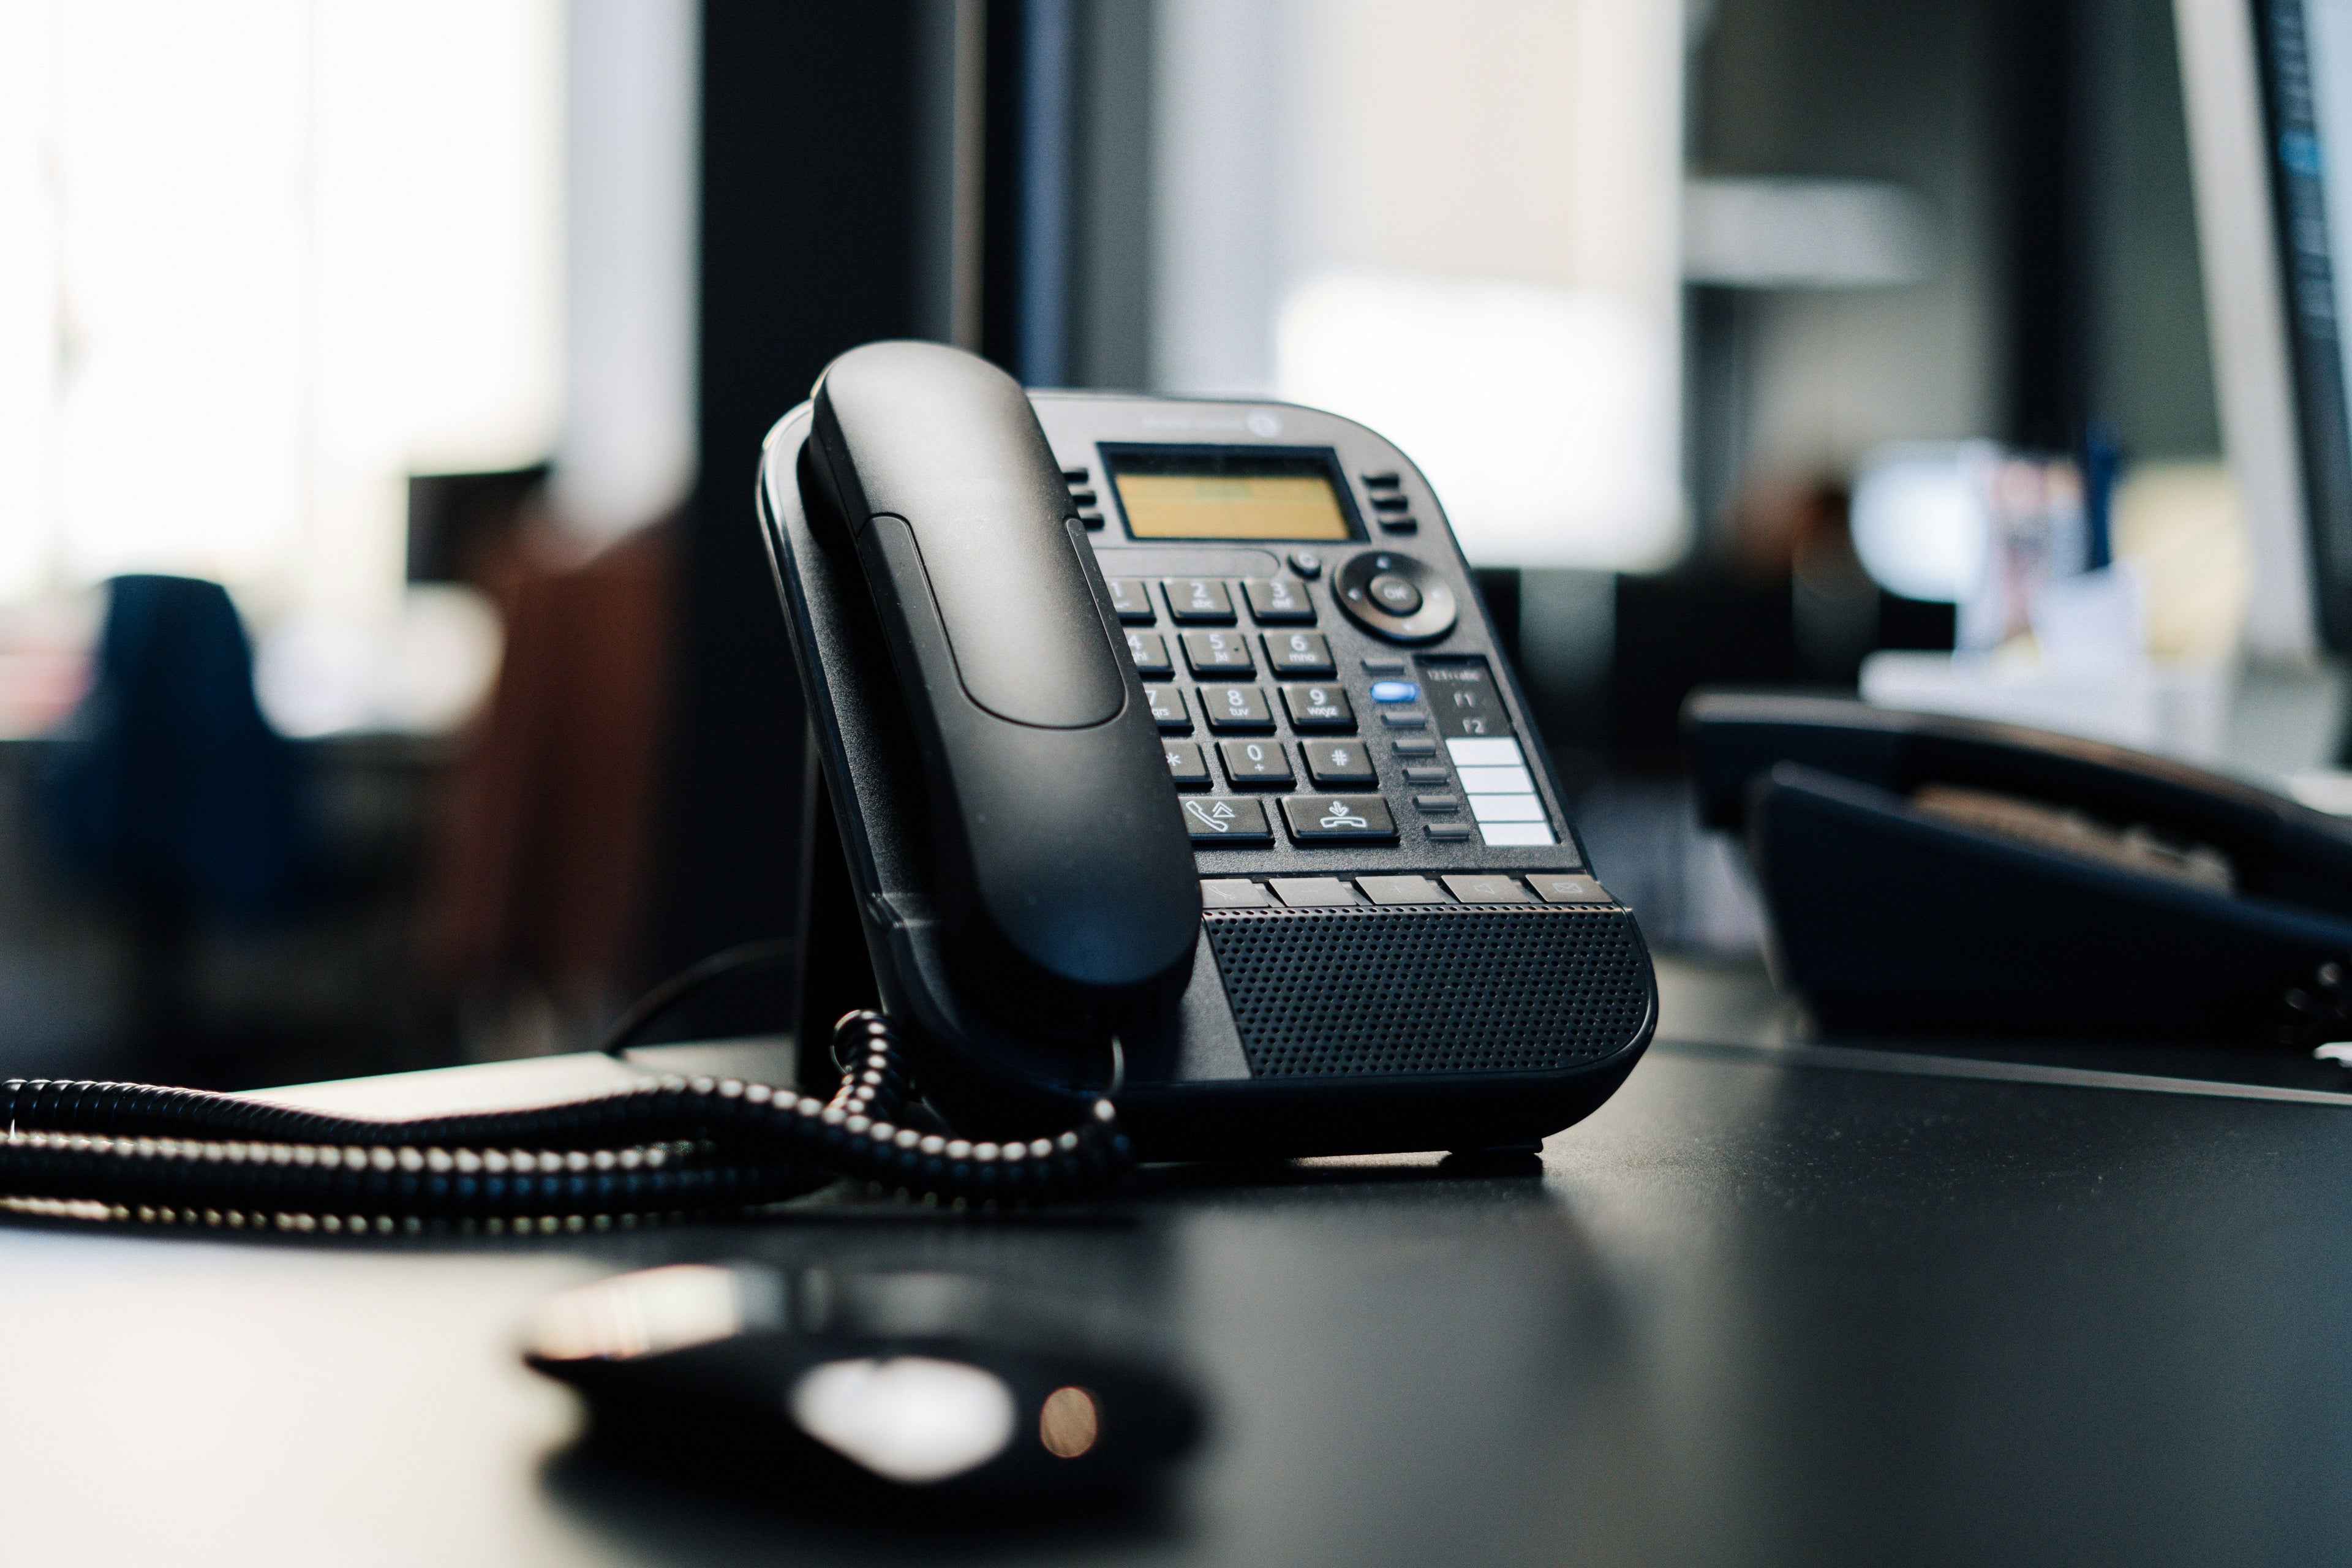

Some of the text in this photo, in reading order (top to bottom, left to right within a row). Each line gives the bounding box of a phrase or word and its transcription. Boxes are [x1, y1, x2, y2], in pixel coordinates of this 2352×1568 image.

[1111, 582, 1122, 597] 1
[1191, 582, 1207, 598] 2
[1270, 582, 1286, 598] 3
[1383, 587, 1407, 600] OK
[1128, 635, 1142, 649] 4
[1209, 635, 1224, 650] 5
[1291, 635, 1306, 651] 6
[1289, 653, 1316, 662] mno
[1145, 690, 1157, 706] 7
[1227, 690, 1243, 705] 8
[1309, 689, 1325, 705] 9
[1453, 693, 1473, 706] F1
[1229, 707, 1250, 717] tuv
[1306, 707, 1339, 718] wxyz
[1462, 719, 1485, 734] F2
[1246, 744, 1263, 761] 0
[1331, 749, 1348, 766] #
